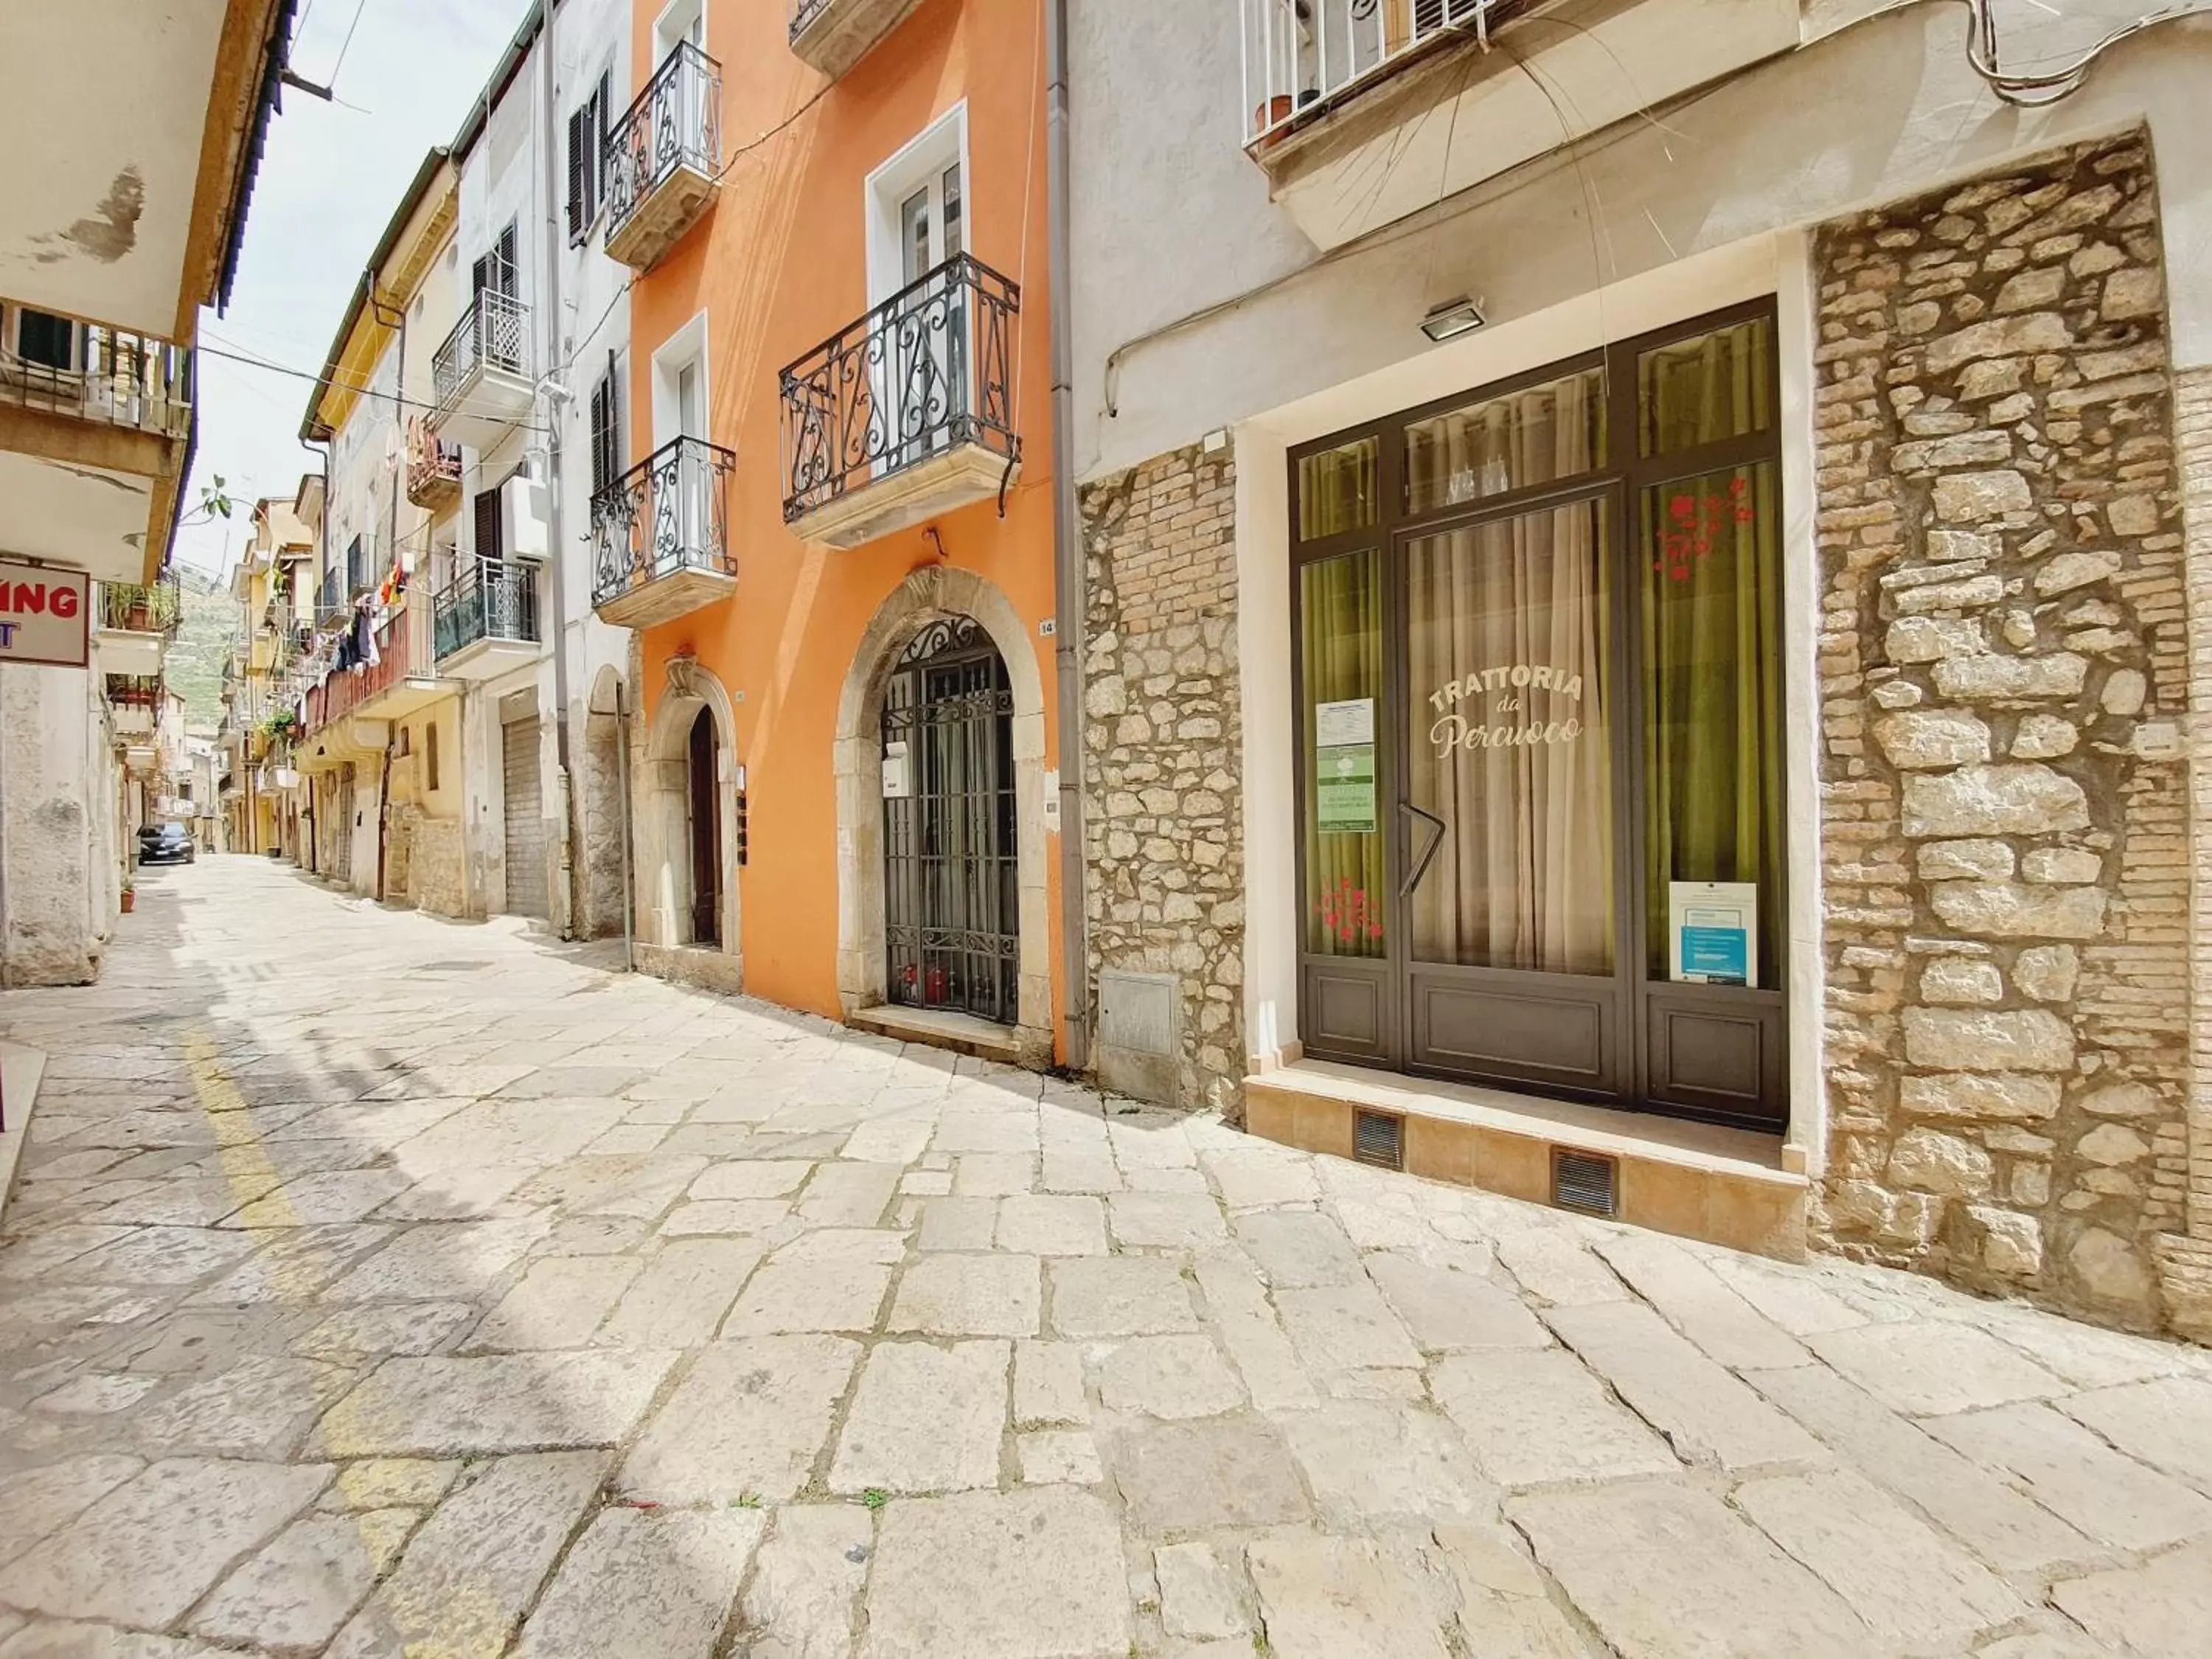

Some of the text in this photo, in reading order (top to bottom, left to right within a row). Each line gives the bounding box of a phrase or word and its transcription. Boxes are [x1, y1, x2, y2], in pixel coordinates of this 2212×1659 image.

[1428, 664, 1582, 712] TRATTORIA
[1496, 695, 1521, 713] da
[1429, 714, 1584, 759] Percuoco
